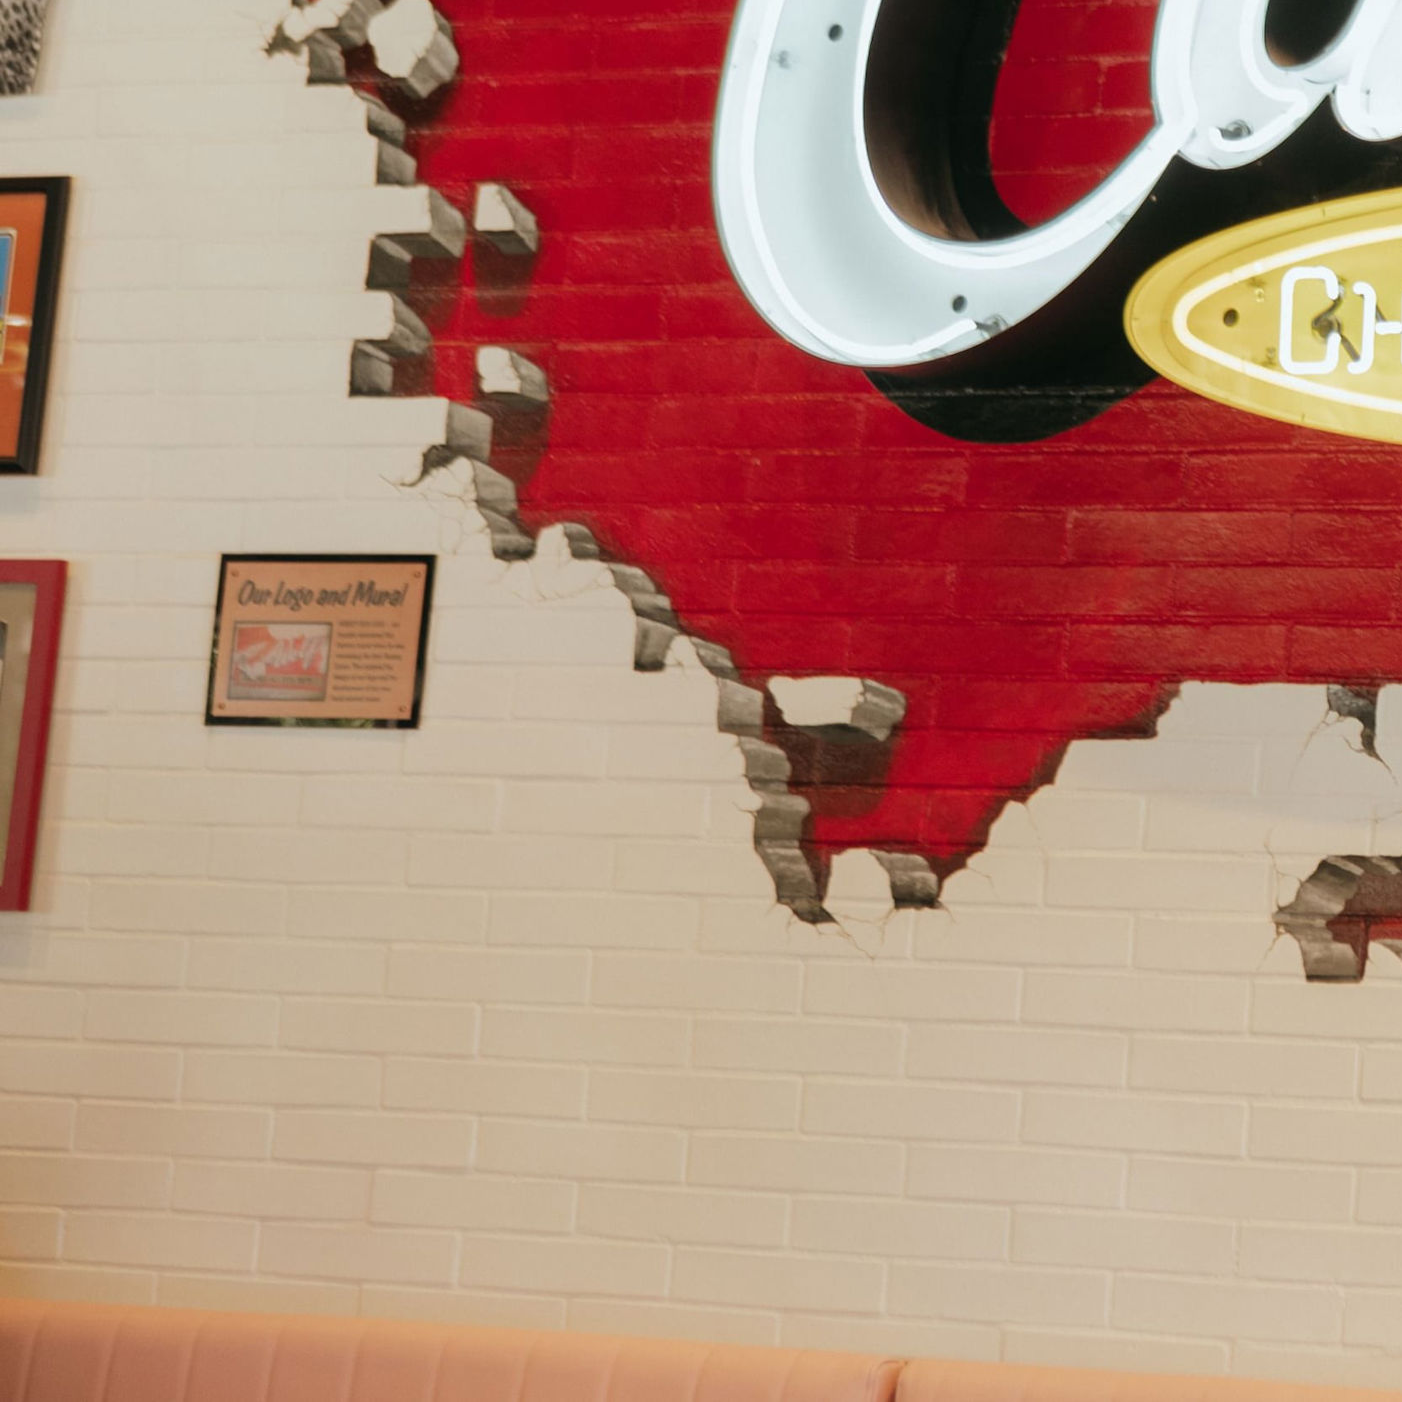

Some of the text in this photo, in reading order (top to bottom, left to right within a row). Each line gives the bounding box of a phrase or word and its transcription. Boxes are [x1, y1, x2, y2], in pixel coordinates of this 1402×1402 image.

[238, 579, 271, 606] Our
[273, 580, 314, 612] Logo
[316, 583, 352, 606] and
